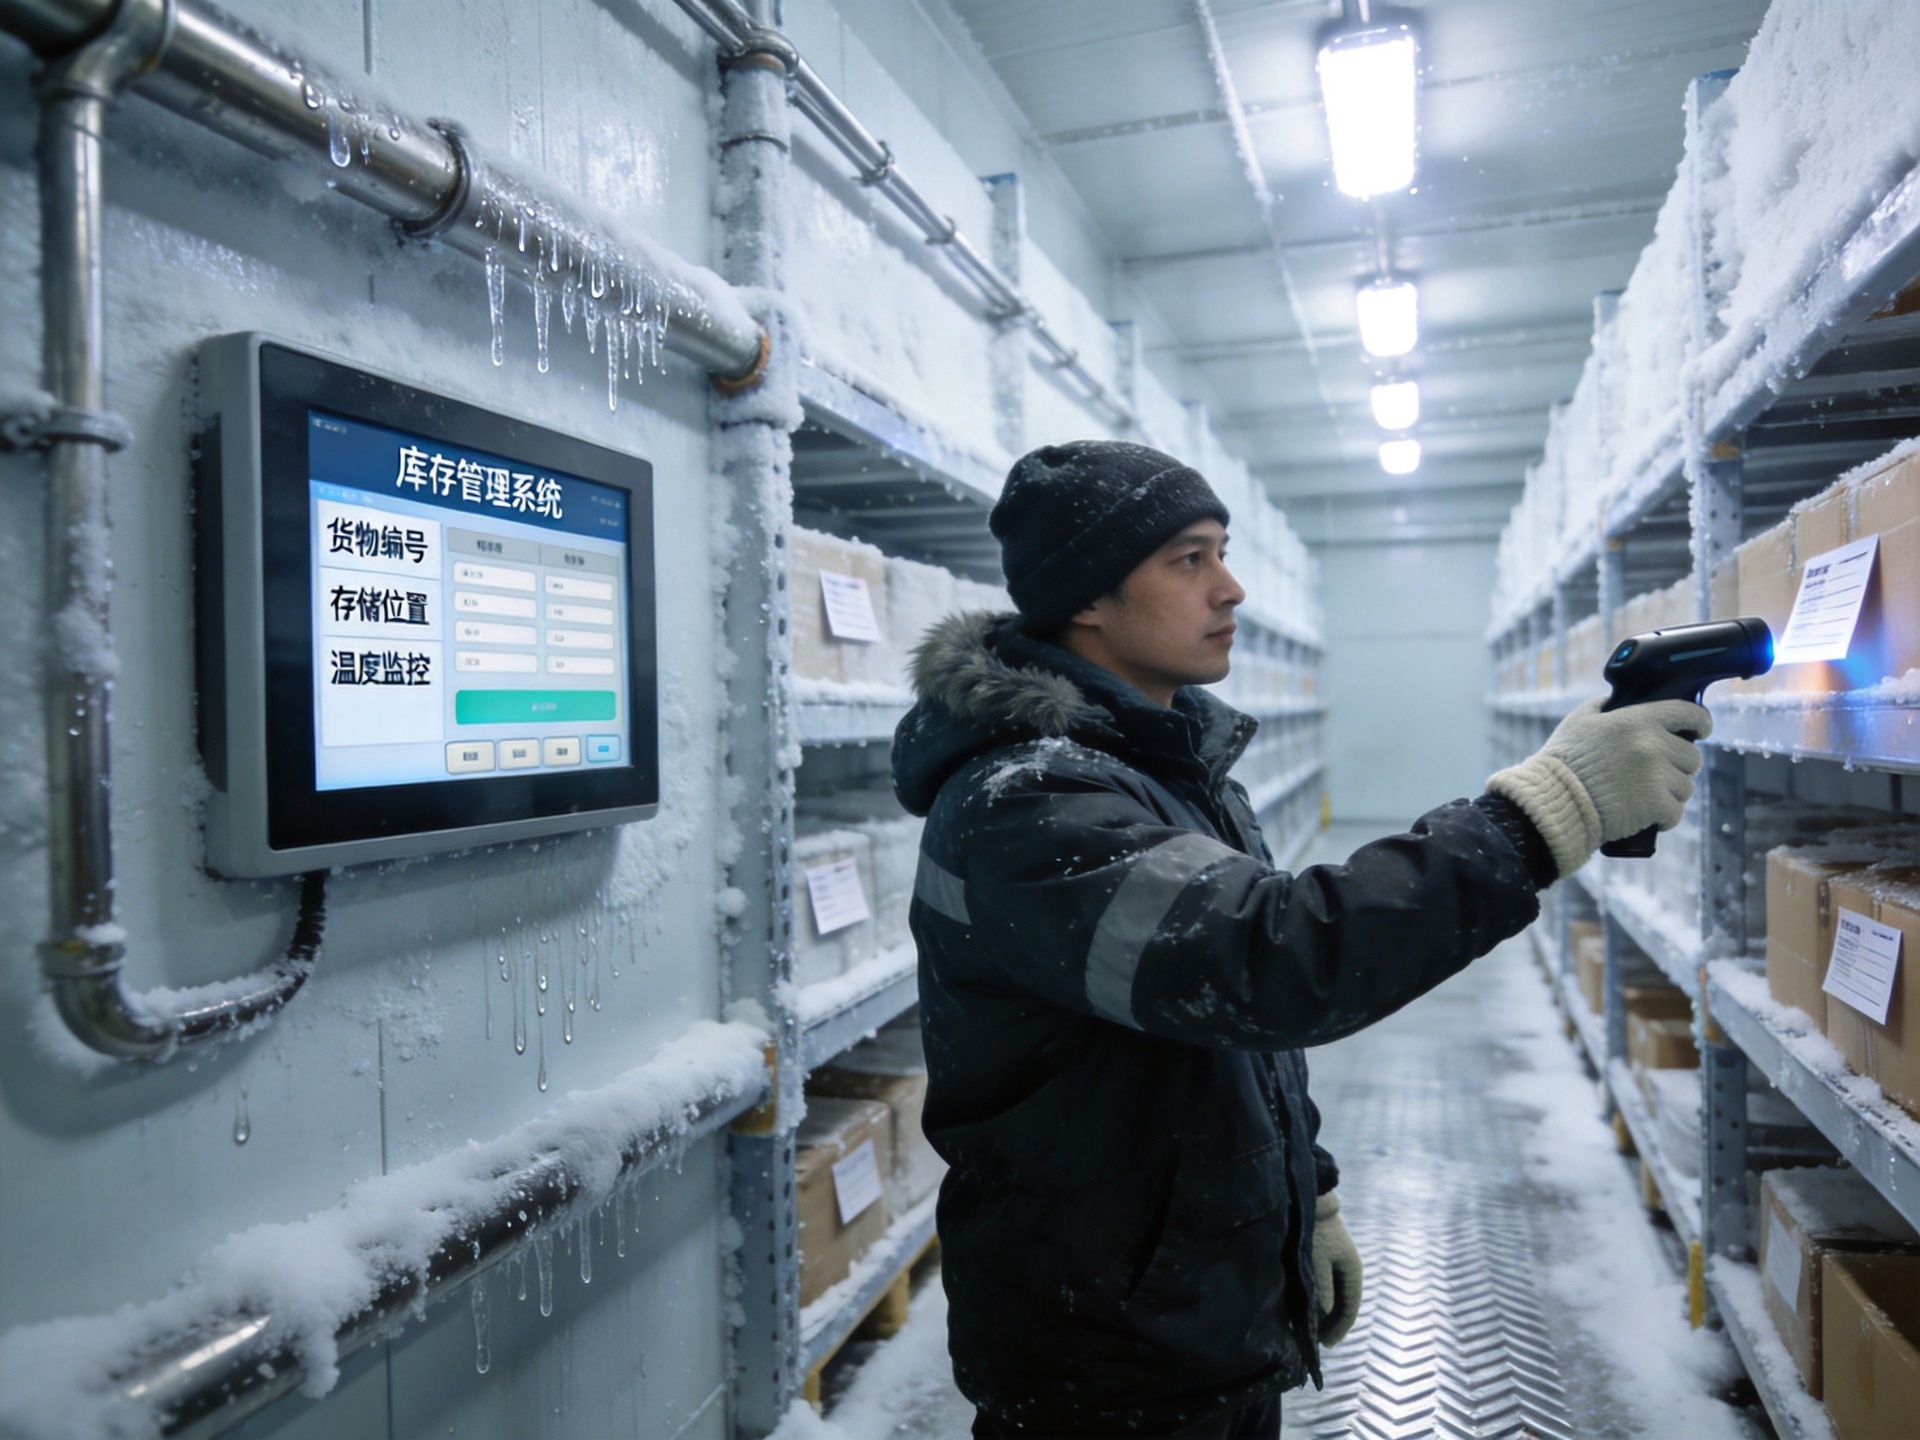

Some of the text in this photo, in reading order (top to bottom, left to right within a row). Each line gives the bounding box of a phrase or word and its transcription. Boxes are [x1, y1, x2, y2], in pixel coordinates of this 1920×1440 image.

[396, 446, 563, 519] 库存管理系统
[327, 516, 429, 564] 货物编号
[330, 585, 431, 626] 存储位置
[330, 649, 431, 686] 温度监控
